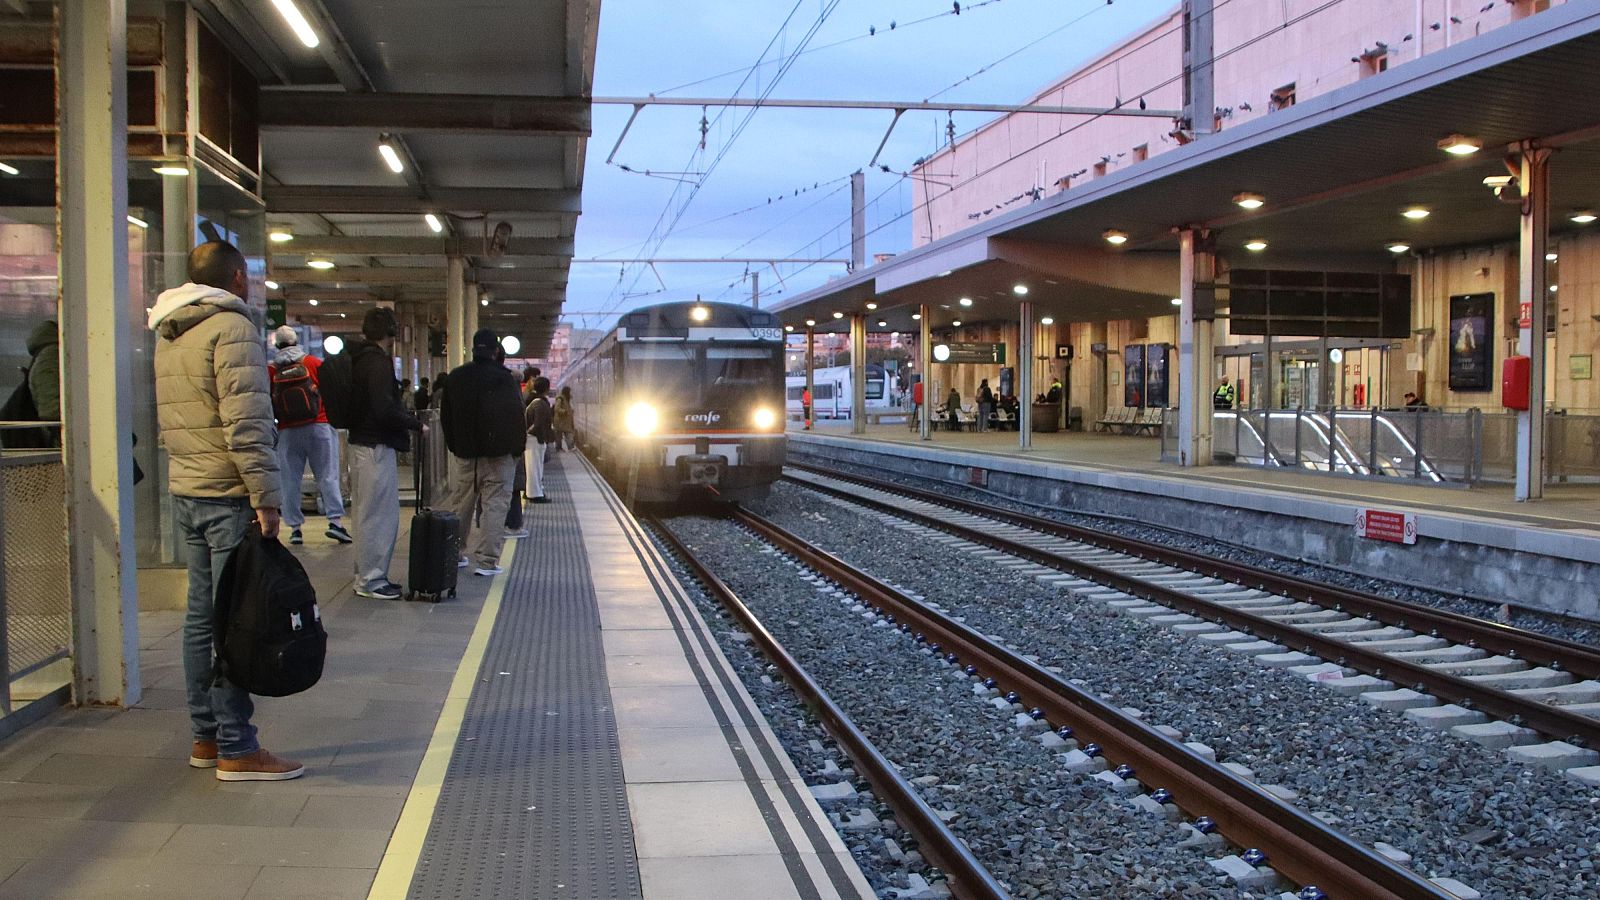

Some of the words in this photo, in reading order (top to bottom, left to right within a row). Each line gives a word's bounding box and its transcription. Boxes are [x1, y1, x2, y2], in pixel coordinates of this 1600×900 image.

[752, 328, 781, 338] 039C
[441, 343, 447, 355] 2
[992, 352, 998, 362] 1
[684, 410, 721, 425] renfe
